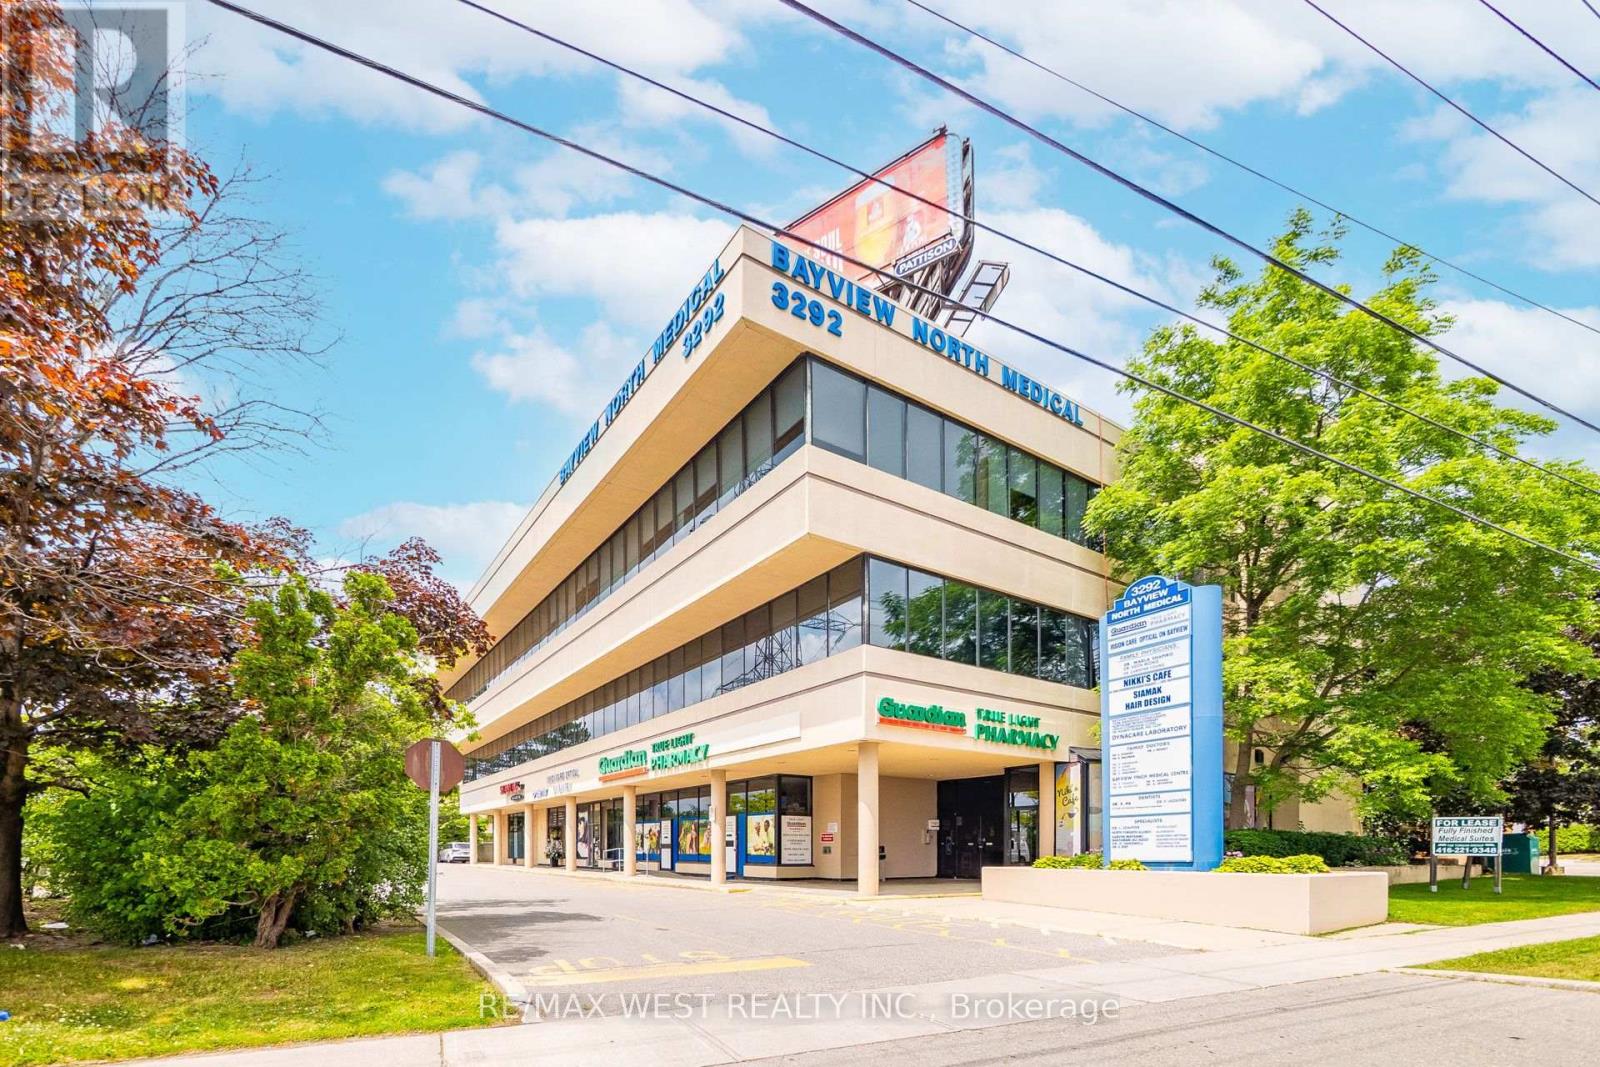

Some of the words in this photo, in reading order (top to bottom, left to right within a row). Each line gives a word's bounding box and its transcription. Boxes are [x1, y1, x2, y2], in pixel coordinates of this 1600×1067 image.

[899, 239, 954, 271] PATTISON
[771, 281, 843, 337] 3292
[683, 292, 725, 358] 3292
[771, 242, 896, 327] BAYVIEW
[912, 317, 989, 377] NORTH
[1001, 365, 1084, 426] MEDICAL
[559, 420, 599, 485] BAYVIEW
[604, 359, 646, 426] NORTH
[652, 258, 724, 364] MEDICAL
[1123, 588, 1169, 608] BAYVIEW
[1131, 580, 1161, 597] 3292
[1111, 606, 1141, 621] NORTH
[1143, 594, 1183, 612] MEDICAL
[1111, 620, 1147, 634] Guardian
[1123, 674, 1151, 687] NIKKI'S
[1153, 670, 1172, 681] CAFE
[1125, 700, 1142, 711] HAIR
[1144, 695, 1171, 707] DESIGN
[1133, 686, 1162, 699] SIAMAK
[879, 697, 968, 728] Guardian
[976, 707, 1006, 723] TRUE
[1008, 713, 1041, 729] LIGHT
[975, 723, 1060, 750] PHARMACY
[1112, 731, 1144, 741] DYNACARE
[1145, 725, 1187, 736] LABORATORY
[598, 749, 648, 775] Guardian
[670, 732, 695, 749] LIGHT
[650, 744, 710, 770] PHARMACY
